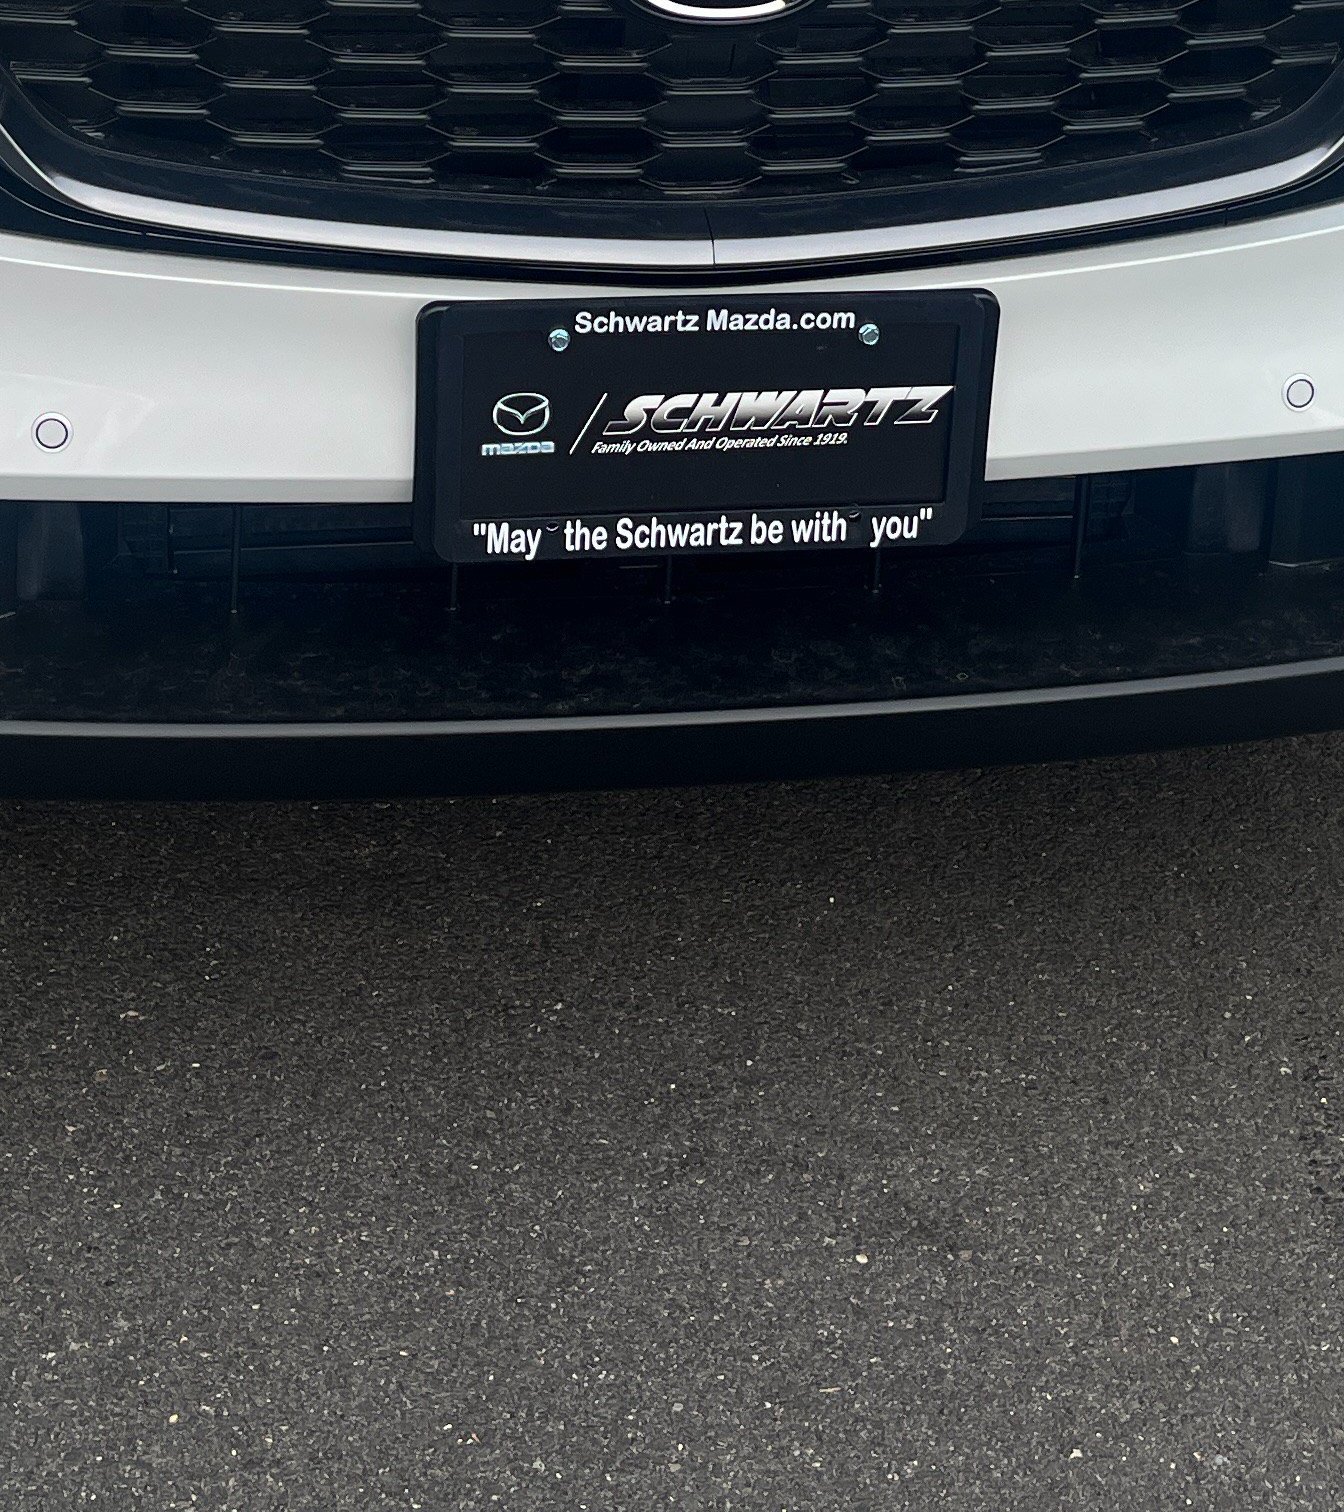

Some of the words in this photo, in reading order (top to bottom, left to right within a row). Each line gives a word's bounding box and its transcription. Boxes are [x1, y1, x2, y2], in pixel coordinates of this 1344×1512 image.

[574, 310, 699, 333] Schwartz
[706, 308, 855, 331] Mazda.com
[602, 385, 954, 435] SCHWARTZ
[591, 440, 637, 455] Family
[637, 437, 686, 452] Owned
[685, 437, 716, 451] And
[715, 435, 774, 451] Operated
[776, 434, 812, 447] Since
[473, 522, 542, 561] "May
[563, 519, 608, 551] the
[615, 515, 744, 550] Schwartz
[750, 513, 784, 544] be
[791, 510, 847, 543] with
[869, 507, 933, 548] you"
